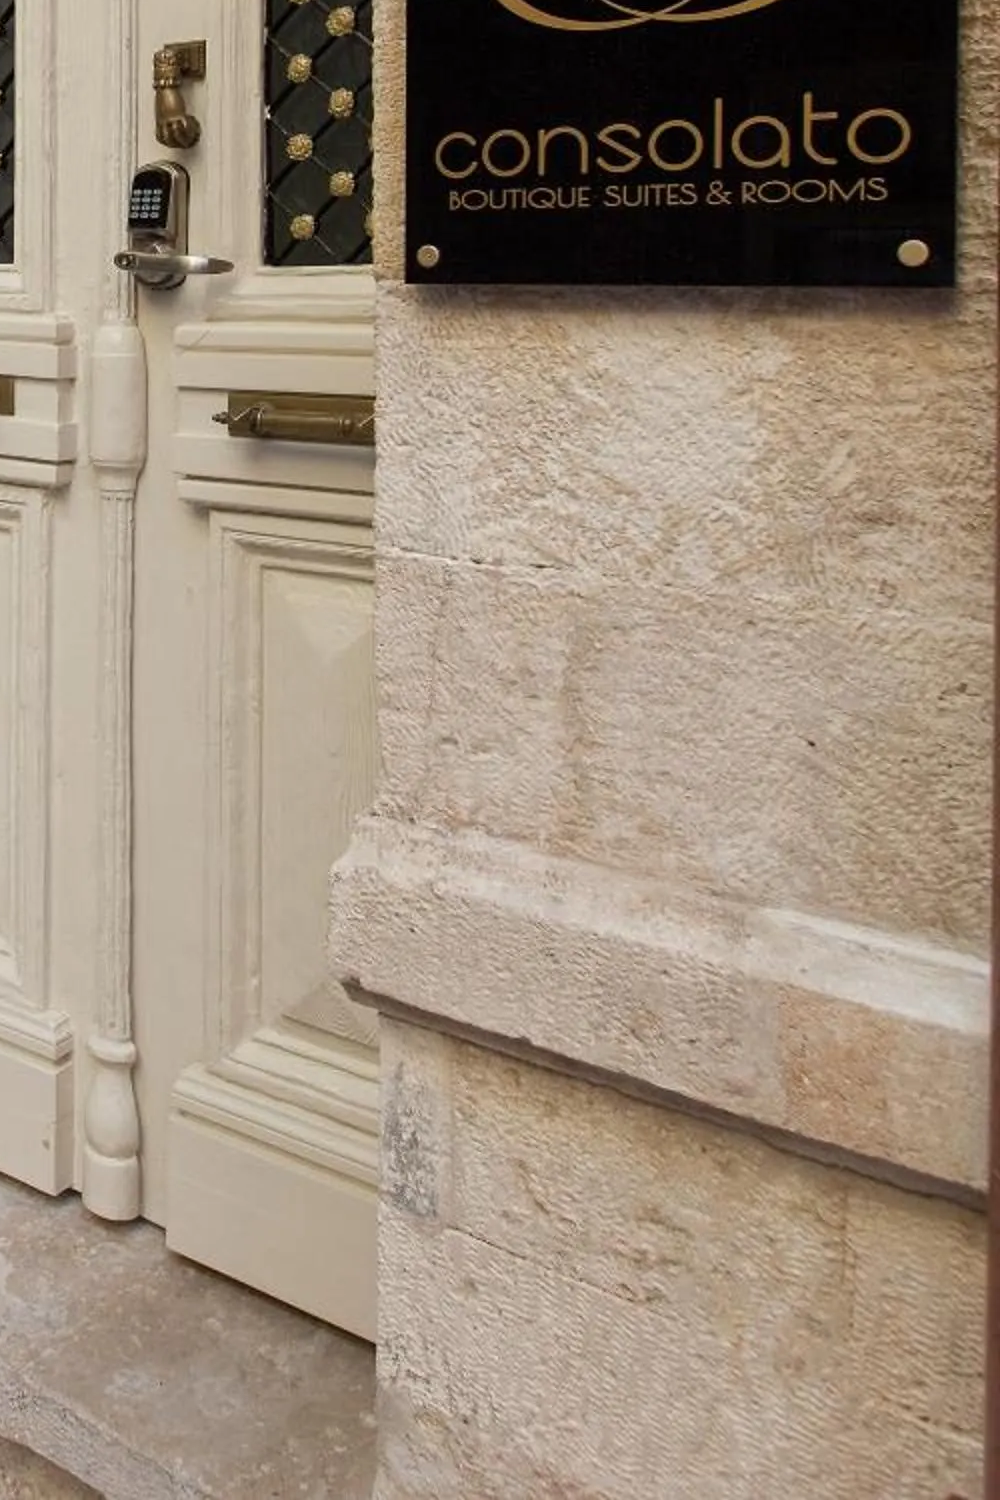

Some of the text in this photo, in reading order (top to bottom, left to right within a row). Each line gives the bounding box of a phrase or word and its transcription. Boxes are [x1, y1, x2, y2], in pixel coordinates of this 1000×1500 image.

[435, 91, 911, 179] consolato
[449, 177, 888, 211] BOUTIQUE SUITES & ROOMS
